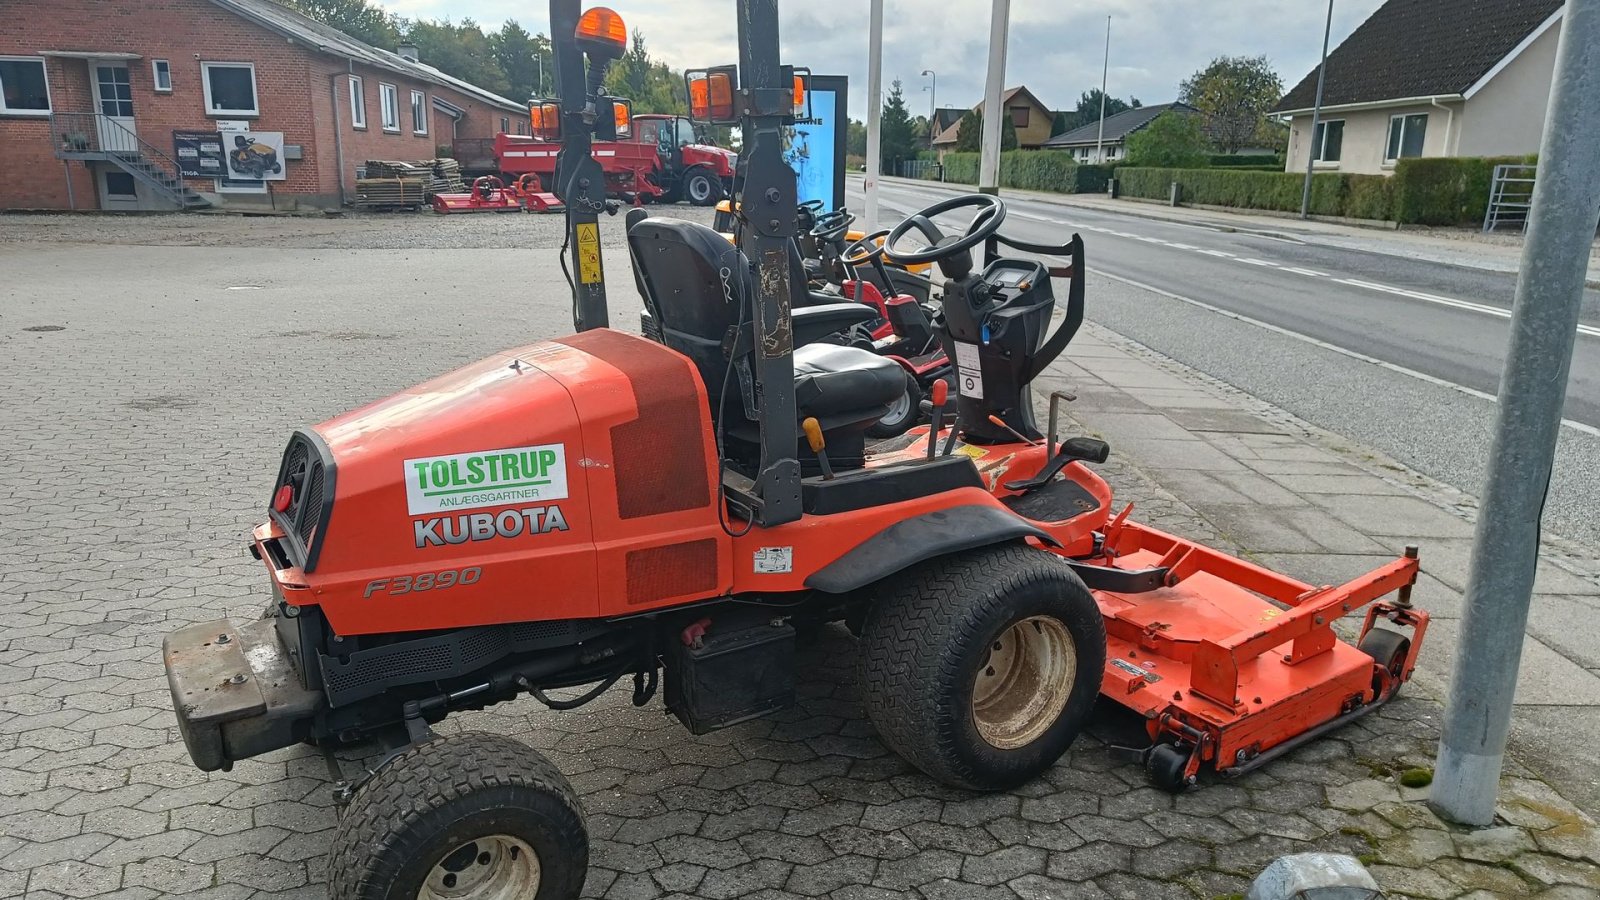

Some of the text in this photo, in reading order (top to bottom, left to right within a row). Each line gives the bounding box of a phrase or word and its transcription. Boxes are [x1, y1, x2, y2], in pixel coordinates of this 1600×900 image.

[414, 450, 556, 489] TOLSTRUP
[439, 488, 539, 507] ANLÆGSGARTNER
[413, 505, 569, 548] KUBOTA
[363, 567, 482, 599] F3890
